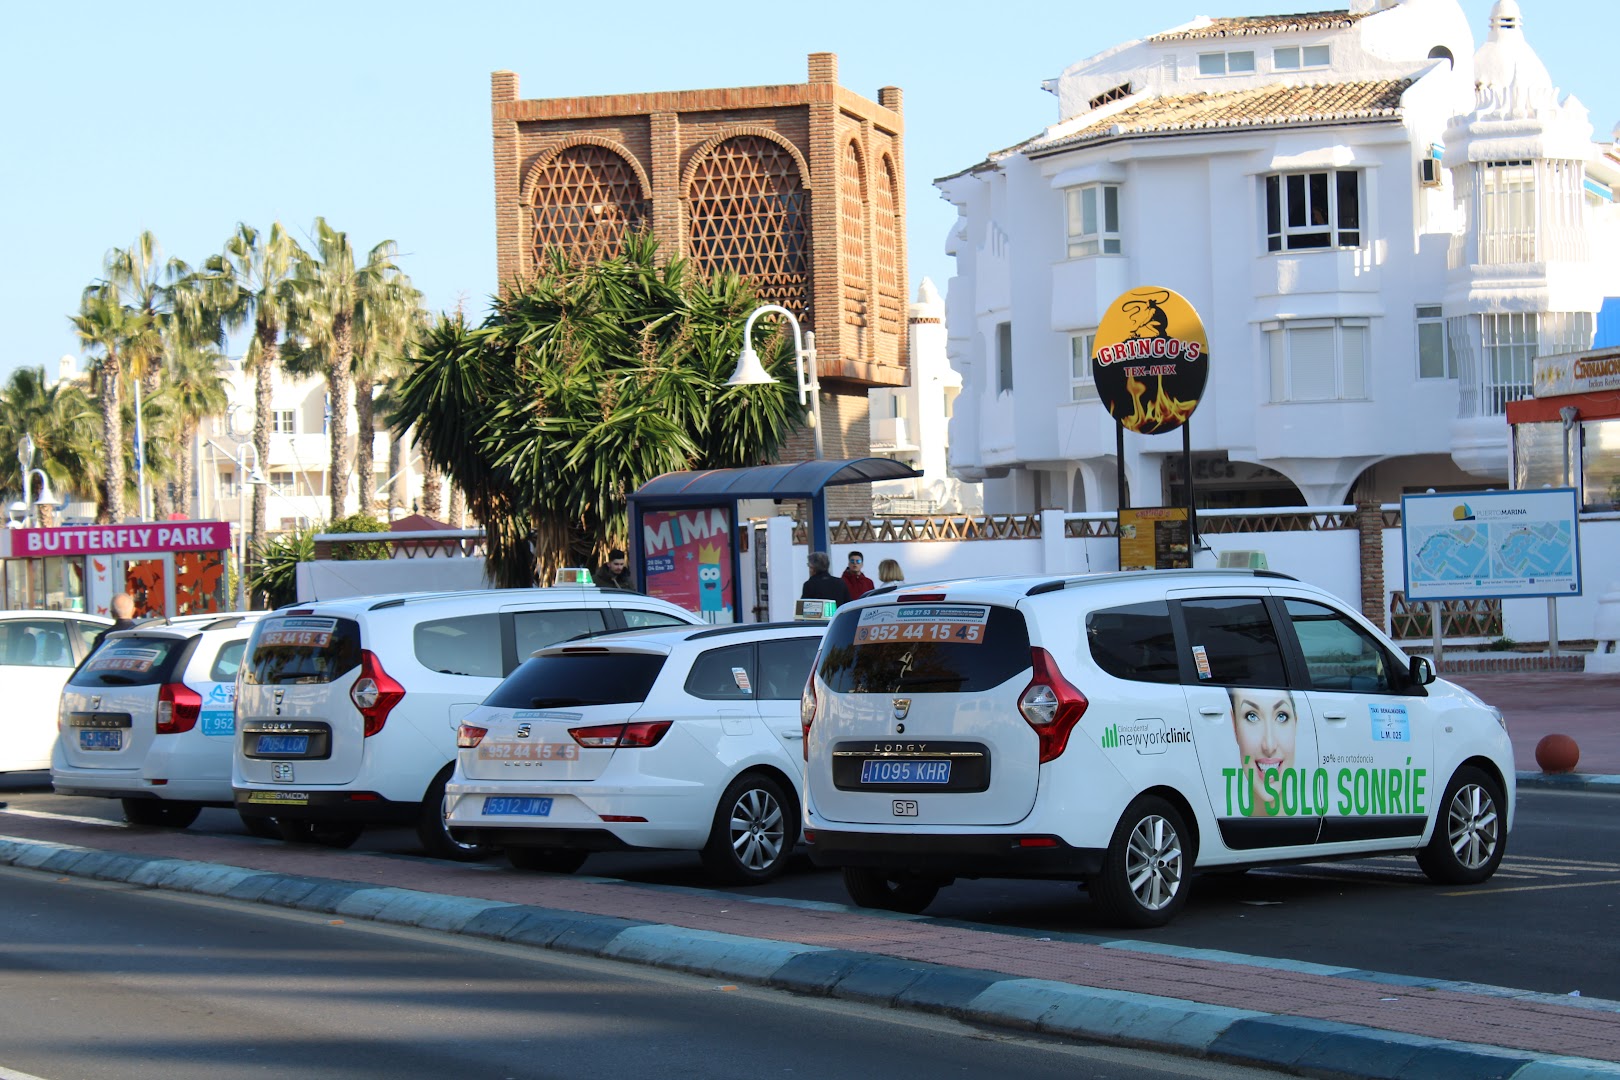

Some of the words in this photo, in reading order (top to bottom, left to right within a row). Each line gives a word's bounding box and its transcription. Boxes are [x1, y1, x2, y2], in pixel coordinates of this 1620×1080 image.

[1097, 338, 1201, 367] GRINGO'S
[1123, 364, 1177, 378] TEX-MEX
[1476, 509, 1527, 517] PUERTOMARINA
[27, 529, 152, 551] BUTTERFLY
[158, 526, 214, 547] PARK
[644, 508, 728, 555] MIMA
[283, 632, 296, 644] 44
[299, 632, 311, 644] 15
[869, 625, 899, 641] 952
[902, 624, 924, 639] 44
[930, 624, 951, 640] 15
[955, 625, 980, 641] 45
[214, 717, 234, 730] 952
[1133, 724, 1149, 732] dental
[262, 738, 286, 751] 7054
[286, 738, 305, 751] LCK
[1119, 727, 1191, 749] newyorkclinic
[488, 744, 511, 758] 952
[513, 744, 530, 758] 44
[535, 744, 552, 759] 15
[556, 744, 575, 759] 45
[874, 744, 926, 752] LODGY
[1322, 754, 1336, 765] 30%
[1337, 755, 1345, 764] en
[1345, 754, 1374, 764] ortodoncia
[274, 765, 290, 779] SP
[874, 762, 911, 780] 1095
[916, 762, 947, 780] KHR
[1222, 756, 1254, 817] TÚ
[1263, 767, 1329, 817] SOLO
[1337, 757, 1426, 816] SONRÍE
[489, 798, 520, 813] 5312
[523, 799, 549, 814] JWG
[895, 802, 915, 815] SP
